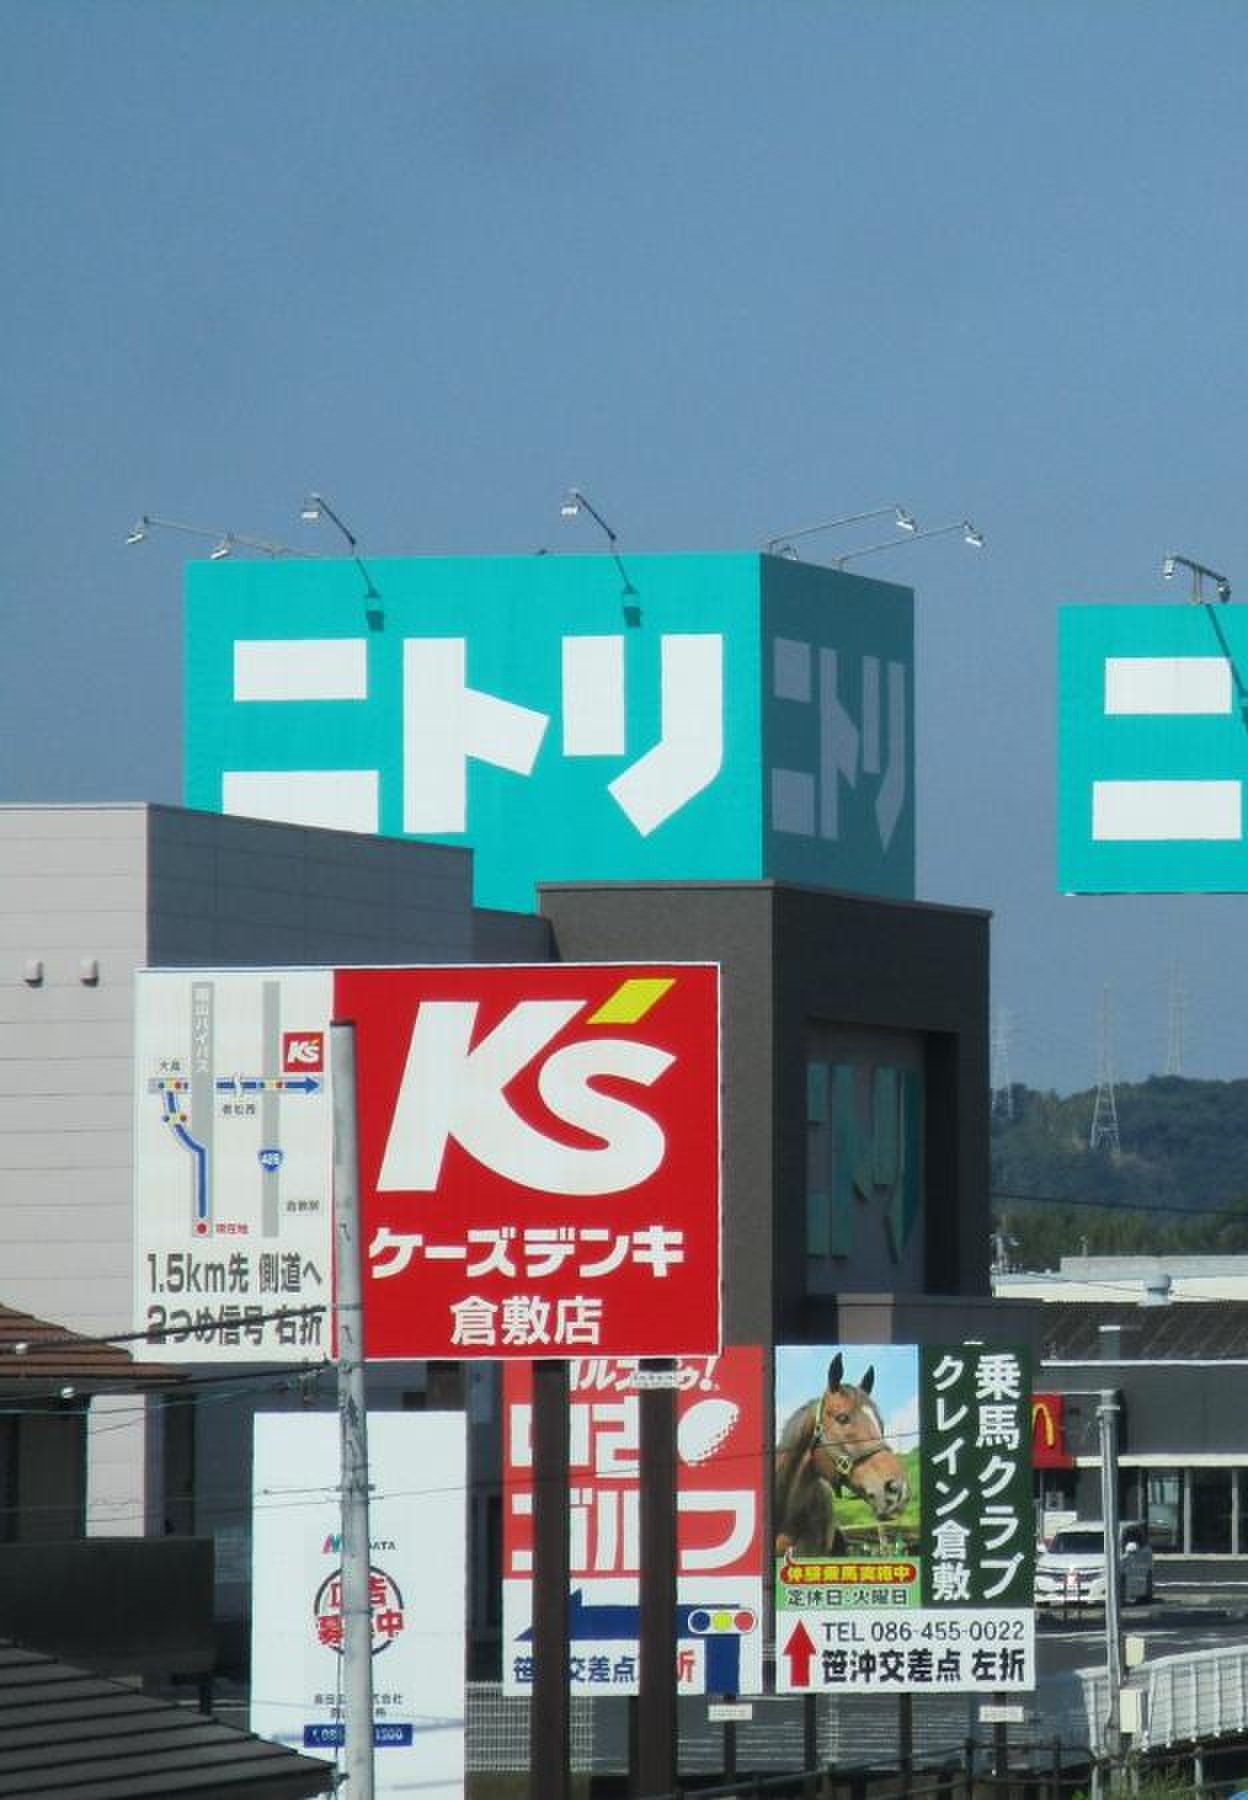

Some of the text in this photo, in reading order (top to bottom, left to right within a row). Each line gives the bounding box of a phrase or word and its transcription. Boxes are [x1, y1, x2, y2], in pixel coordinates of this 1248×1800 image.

[221, 633, 724, 838] ニトリ
[772, 635, 906, 854] ニトリ
[147, 1252, 249, 1294] 1.5km先
[369, 1226, 685, 1280] ケーズデンキ
[450, 1296, 603, 1346] 倉敷店
[931, 1354, 972, 1601] クレイン倉敷
[975, 1353, 1025, 1600] 乗馬クラブ
[822, 1620, 1025, 1643] TEL 086-455-0022
[513, 1655, 636, 1684] 笹交差点
[821, 1648, 1026, 1684] 笹沖交差点 左折
